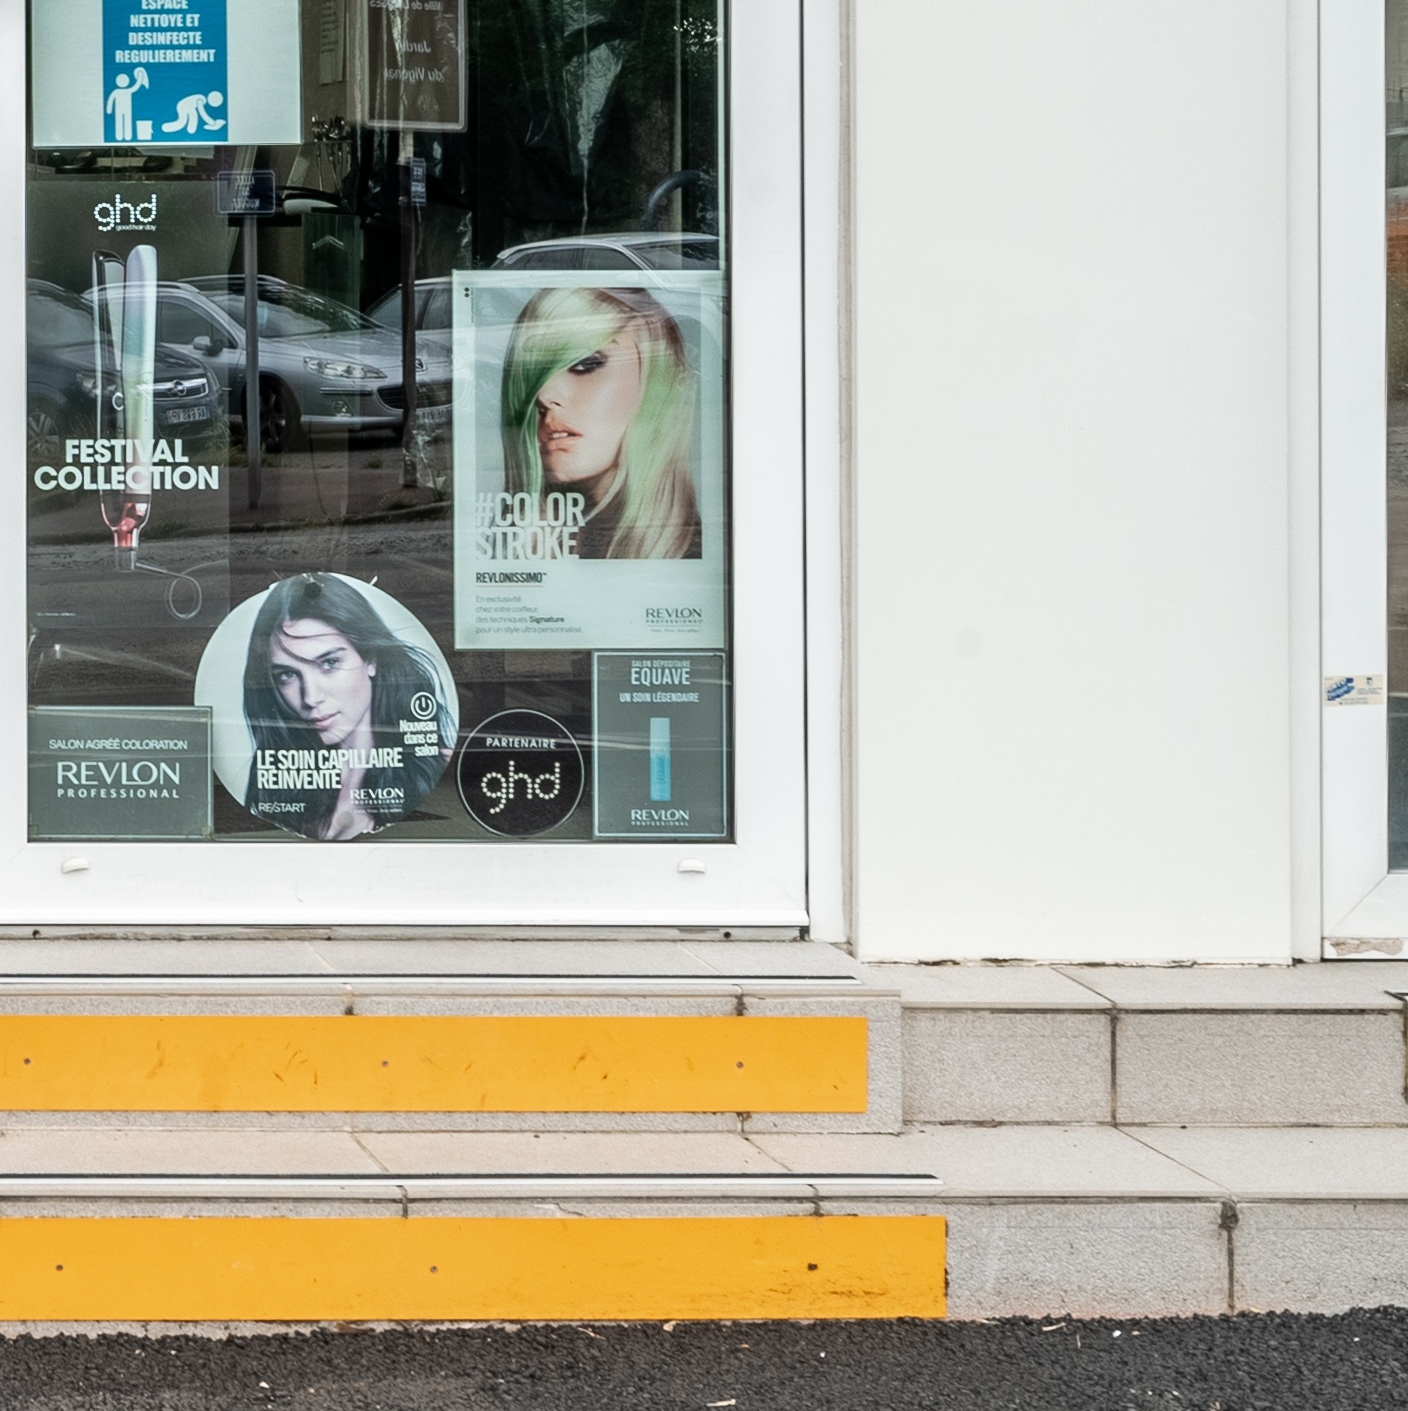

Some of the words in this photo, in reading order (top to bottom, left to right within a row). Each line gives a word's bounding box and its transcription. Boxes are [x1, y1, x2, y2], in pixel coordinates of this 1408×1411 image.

[129, 14, 184, 28] NETTOYE
[185, 14, 200, 27] ET
[128, 32, 203, 45] DESINFECTE
[115, 49, 216, 64] REGULIEREMENT
[93, 193, 157, 231] ghd
[65, 439, 189, 464] FESTIVAL
[34, 465, 220, 491] COLLECTION
[475, 492, 586, 527] #COLOR
[475, 526, 580, 559] STROKE
[475, 595, 485, 603] En
[486, 595, 522, 603] exclusivité
[475, 605, 492, 613] chez
[645, 607, 703, 618] REVLON
[489, 616, 528, 624] techniques
[529, 615, 565, 625] Signature
[503, 627, 521, 635] style
[652, 659, 691, 667] DÉPOSITAIRE
[631, 668, 691, 685] EQUAVE
[619, 693, 632, 702] UN
[632, 692, 651, 702] SOIN
[652, 690, 700, 703] LÉGENDAIRE
[399, 719, 438, 731] Nouveau
[49, 739, 84, 750] SALON
[85, 737, 120, 750] AGRÉÉ
[121, 739, 188, 750] COLORATION
[403, 733, 426, 744] dans
[426, 735, 439, 744] ce
[485, 737, 557, 749] PARTENAIRE
[414, 746, 439, 757] salon
[256, 749, 276, 770] LE
[277, 750, 317, 770] SOIN
[318, 747, 405, 770] CAPILLAIRE
[56, 761, 181, 785] REVLON
[350, 787, 405, 798] REVLON
[480, 760, 561, 815] ghd
[56, 789, 180, 799] PROFESSIONAL
[257, 801, 306, 813] RE/START
[631, 809, 690, 821] REVLON
